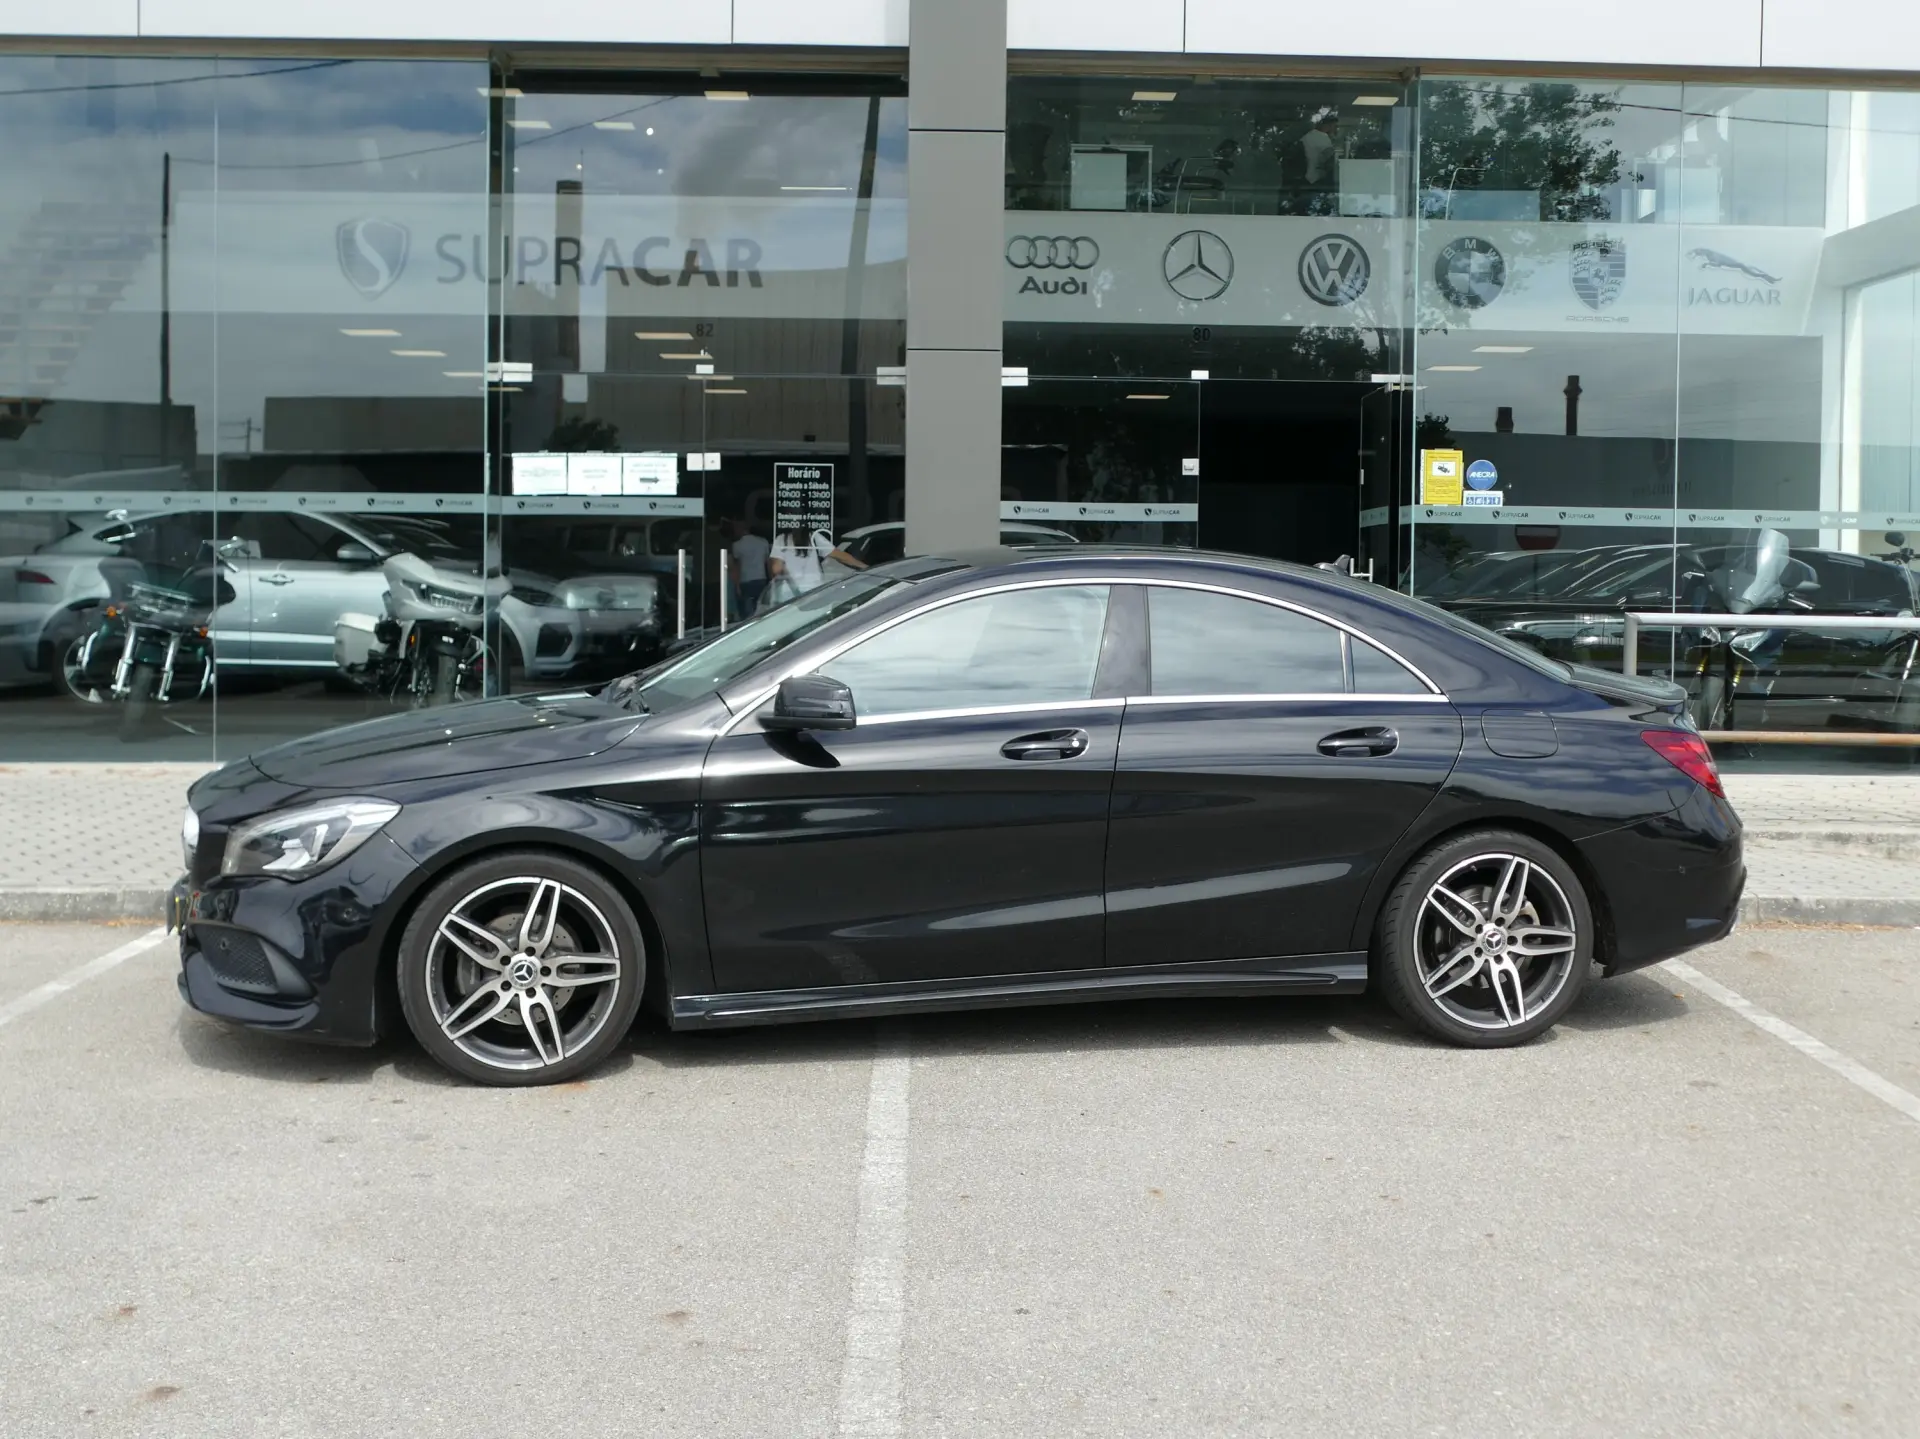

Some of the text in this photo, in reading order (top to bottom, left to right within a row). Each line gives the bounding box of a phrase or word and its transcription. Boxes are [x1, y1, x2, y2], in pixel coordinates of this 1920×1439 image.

[434, 233, 764, 287] SUPRACAR
[1018, 276, 1088, 295] Audi
[1687, 286, 1782, 306] JAGUAR
[695, 323, 714, 338] 82
[1192, 327, 1211, 342] 80
[788, 467, 821, 479] Horário
[807, 491, 831, 499] 13h00
[777, 500, 801, 508] 14h00
[807, 500, 831, 508] 19h00
[777, 521, 800, 529] 15h00
